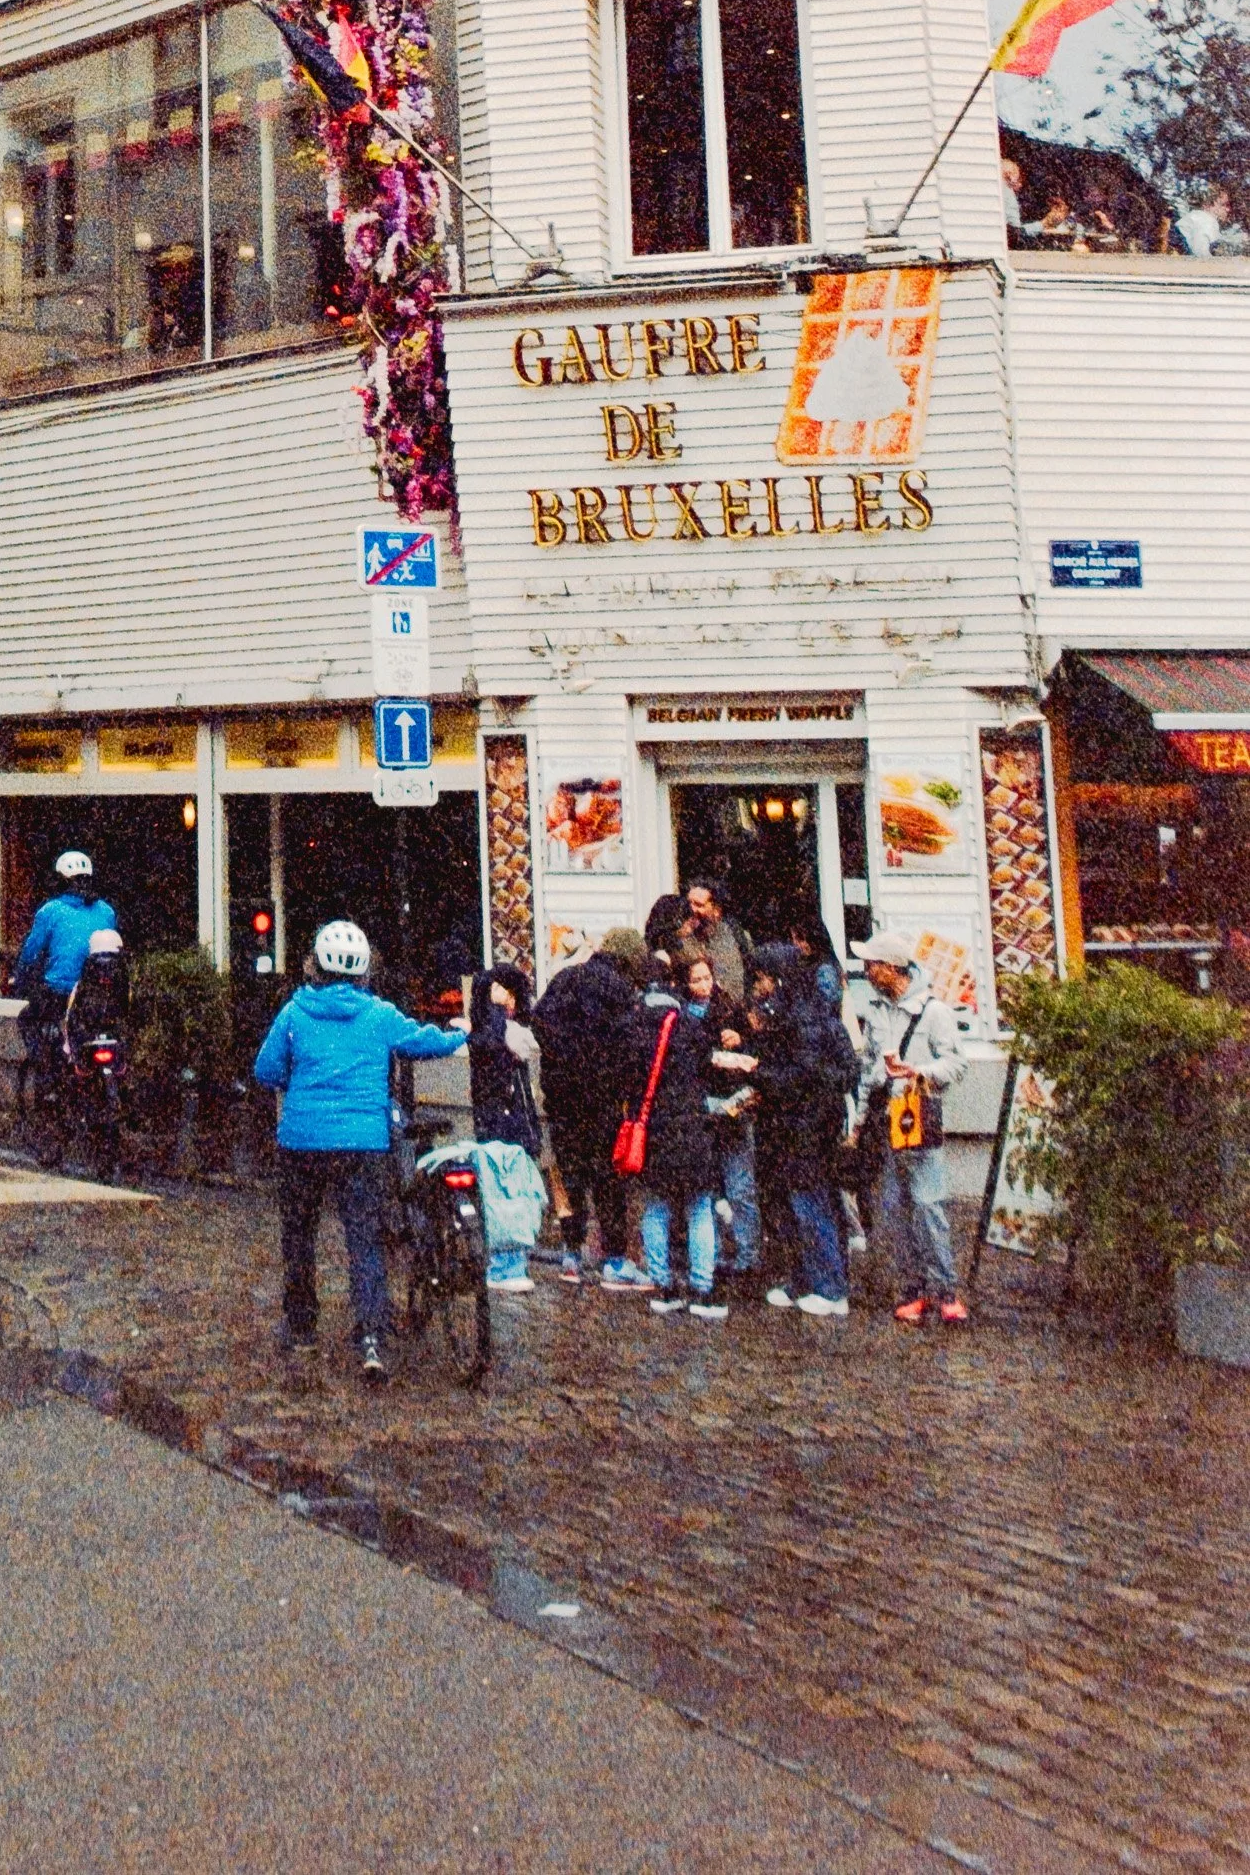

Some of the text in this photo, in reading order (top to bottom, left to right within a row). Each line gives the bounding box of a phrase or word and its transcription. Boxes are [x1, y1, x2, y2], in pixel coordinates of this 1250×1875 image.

[511, 312, 767, 387] GAUFRE
[599, 401, 684, 462] DE
[527, 469, 934, 547] BRUXELLES
[387, 598, 414, 609] ZONE
[647, 703, 855, 724] BELGIAN FRESH WAFFLE
[1194, 735, 1250, 769] TEA
